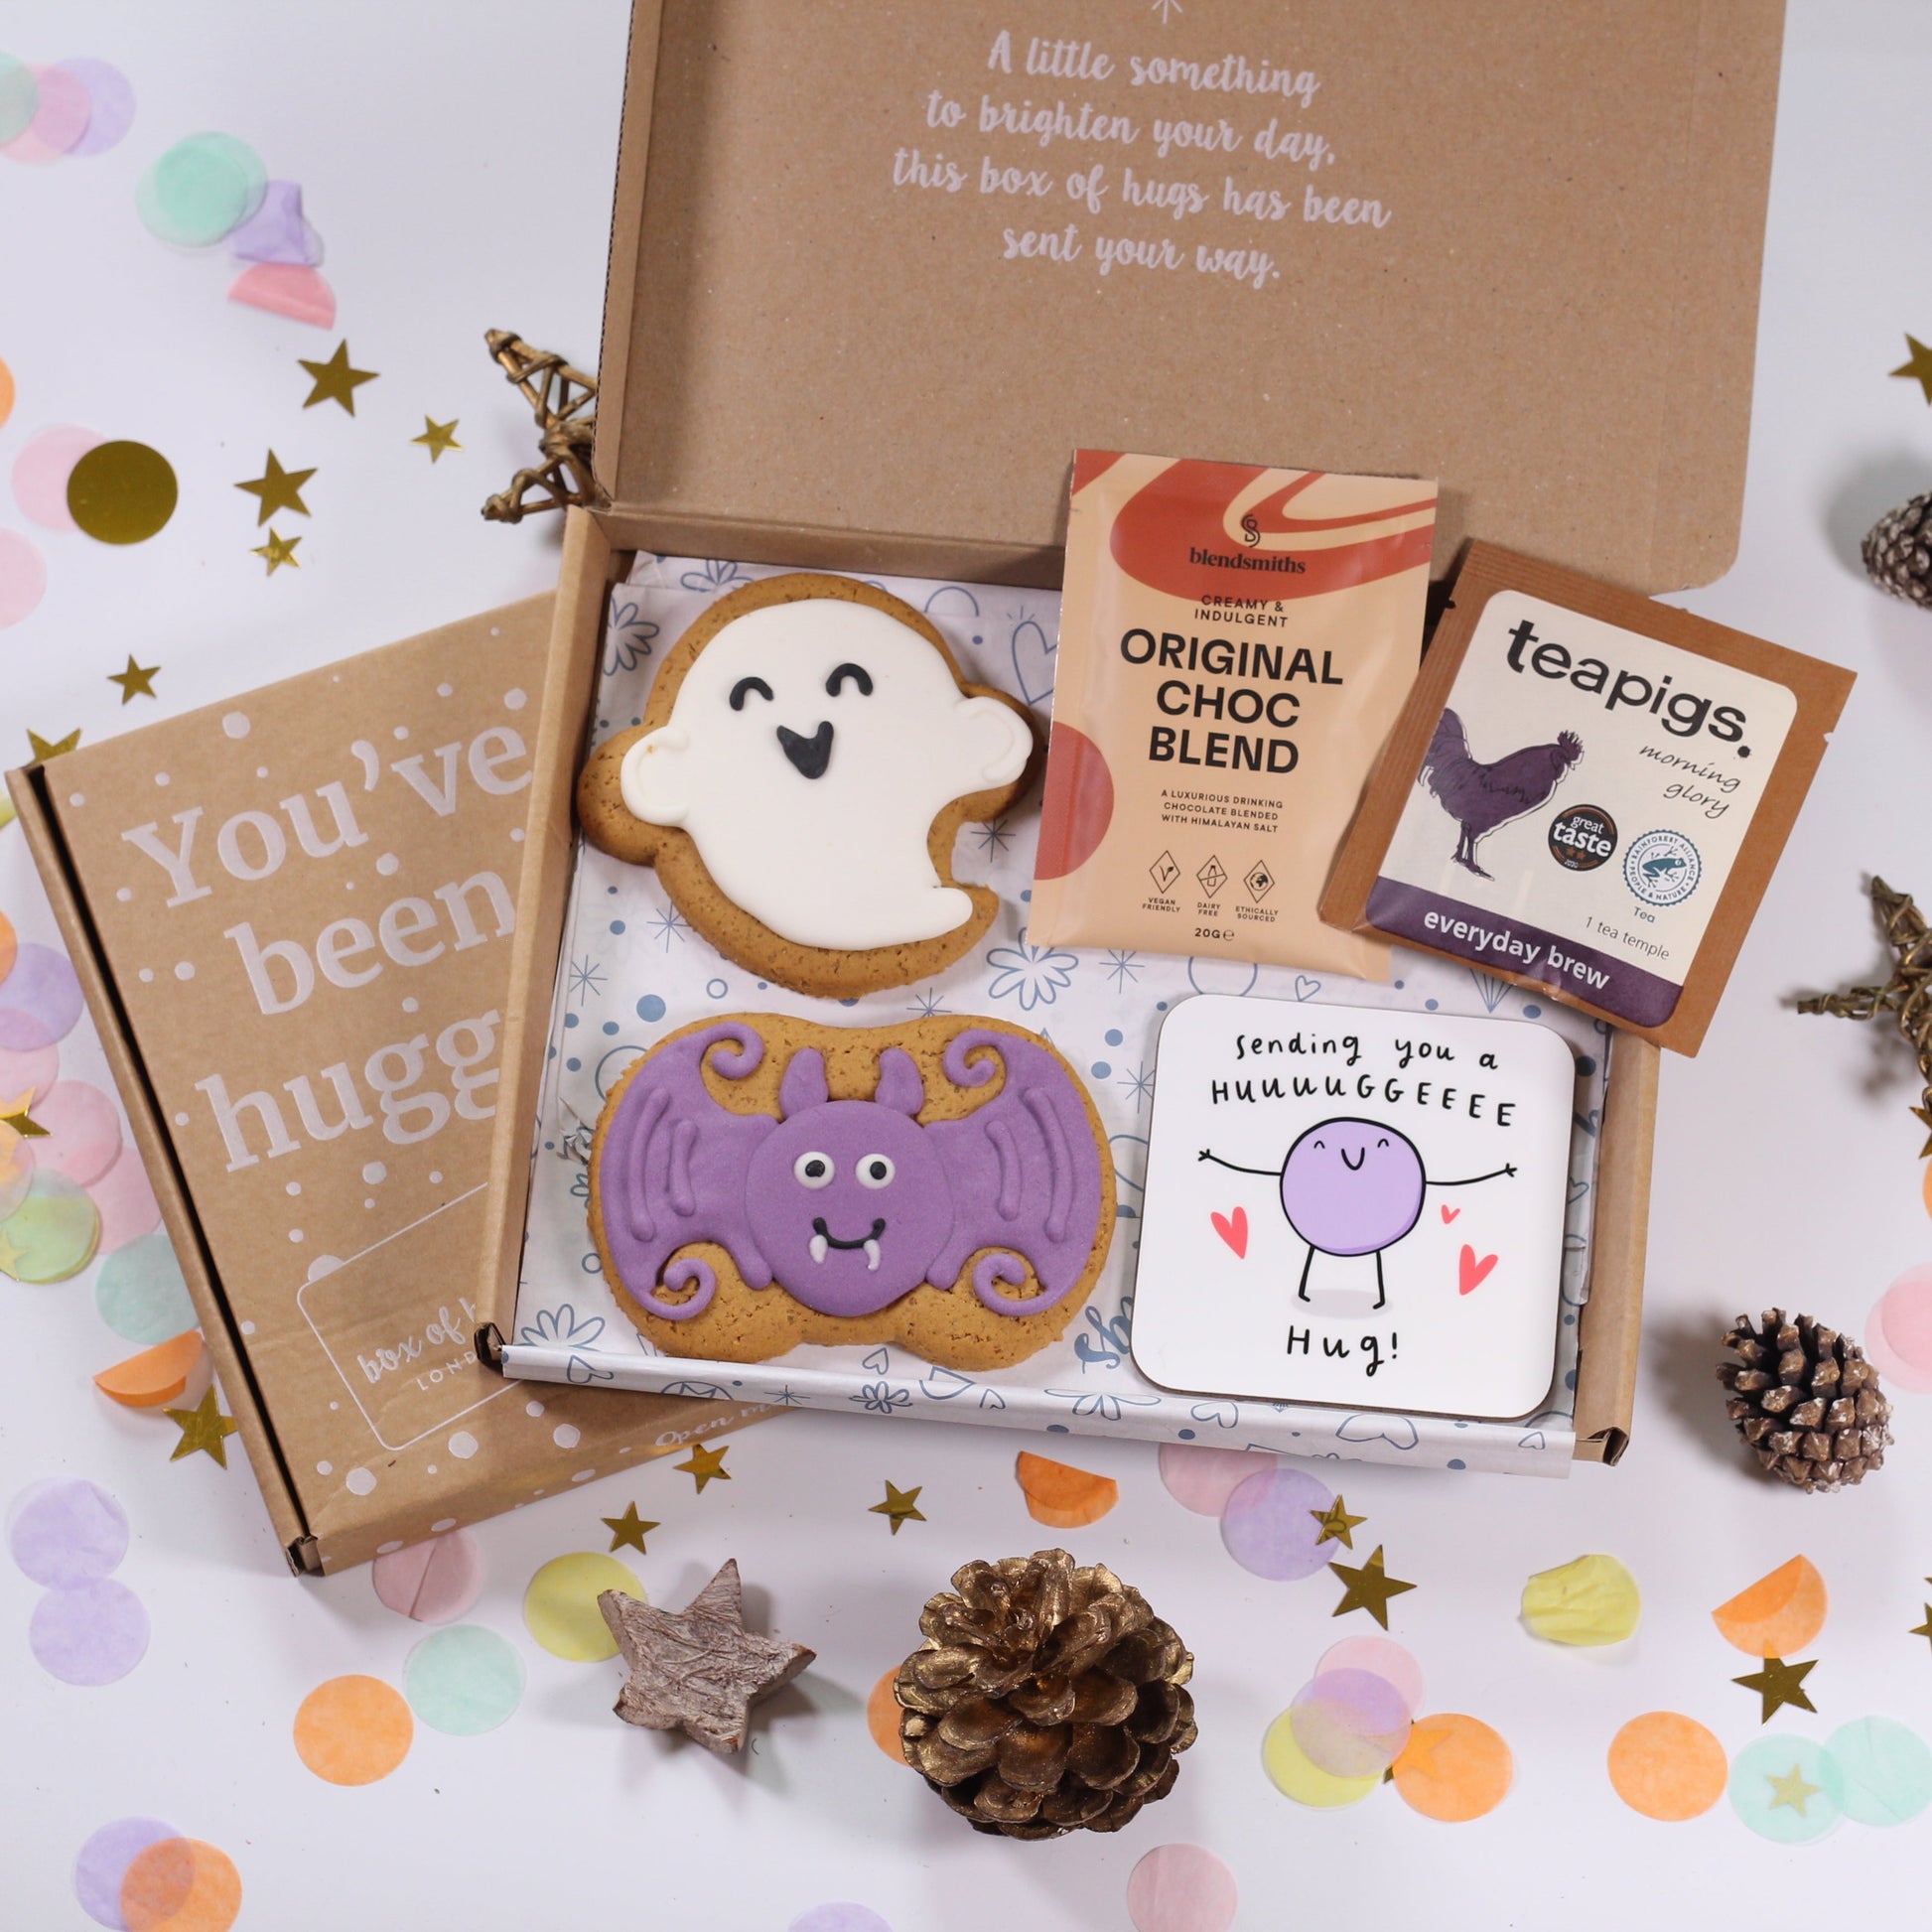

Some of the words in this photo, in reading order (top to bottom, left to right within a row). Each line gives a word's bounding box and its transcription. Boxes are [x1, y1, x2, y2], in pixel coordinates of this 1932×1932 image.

[988, 30, 1012, 74] A
[1026, 37, 1115, 80] little
[1130, 53, 1321, 108] something
[925, 89, 967, 128] to
[978, 94, 1141, 146] brighten
[1153, 118, 1243, 158] your
[1254, 117, 1336, 172] day,
[893, 147, 967, 194] this
[980, 156, 1054, 198] box
[1066, 164, 1110, 214] of
[1123, 168, 1210, 220] hugs
[1223, 176, 1292, 221] has
[1303, 185, 1392, 228] been
[1003, 223, 1083, 262] sent
[1095, 234, 1186, 276] your
[1195, 244, 1281, 290] way.
[1189, 546, 1306, 574] blendsmiths
[1194, 609, 1288, 627] INDULGENT
[1201, 595, 1268, 610] CREAMY
[1274, 602, 1284, 613] &
[1120, 627, 1344, 685] ORIGINAL
[1156, 679, 1301, 728] CHOC
[1504, 619, 1752, 759] teapigs.
[1148, 726, 1300, 774] BLEND
[1639, 746, 1741, 793] morning
[1164, 802, 1228, 815] CHOCOLATE
[1230, 808, 1279, 821] BLENDED
[1171, 790, 1230, 803] LUXURIOUS
[1233, 796, 1284, 809] DRINKING
[1663, 783, 1729, 819] glory
[1162, 814, 1187, 824] WITH
[1190, 816, 1251, 830] HIMALAYAN
[1253, 823, 1279, 833] SALT
[1553, 821, 1611, 857] taste
[1570, 816, 1604, 834] great
[1633, 835, 1678, 860] RAINFOREST
[1679, 843, 1697, 882] ALLIANCE
[1629, 866, 1648, 894] PEOPLE
[1656, 886, 1687, 900] NATURE
[1142, 903, 1180, 912] FRIENDLY
[1148, 897, 1175, 905] VEGAN
[1197, 901, 1221, 910] DAIRY
[1197, 908, 1218, 917] FREE
[1235, 905, 1279, 916] ETHICALLY
[1237, 912, 1276, 922] SOURCED
[1633, 906, 1656, 923] Tea
[223, 870, 517, 1015] been
[1423, 910, 1541, 965] everyday
[1547, 945, 1610, 990] brew
[1586, 915, 1592, 928] 1
[1596, 921, 1619, 939] tea
[1622, 931, 1670, 960] temple
[1394, 1038, 1455, 1070] you
[1478, 1051, 1499, 1070] a
[357, 1335, 422, 1383] box
[426, 1306, 466, 1344] of
[1287, 1325, 1399, 1376] Hug!
[655, 1416, 735, 1447] Open
